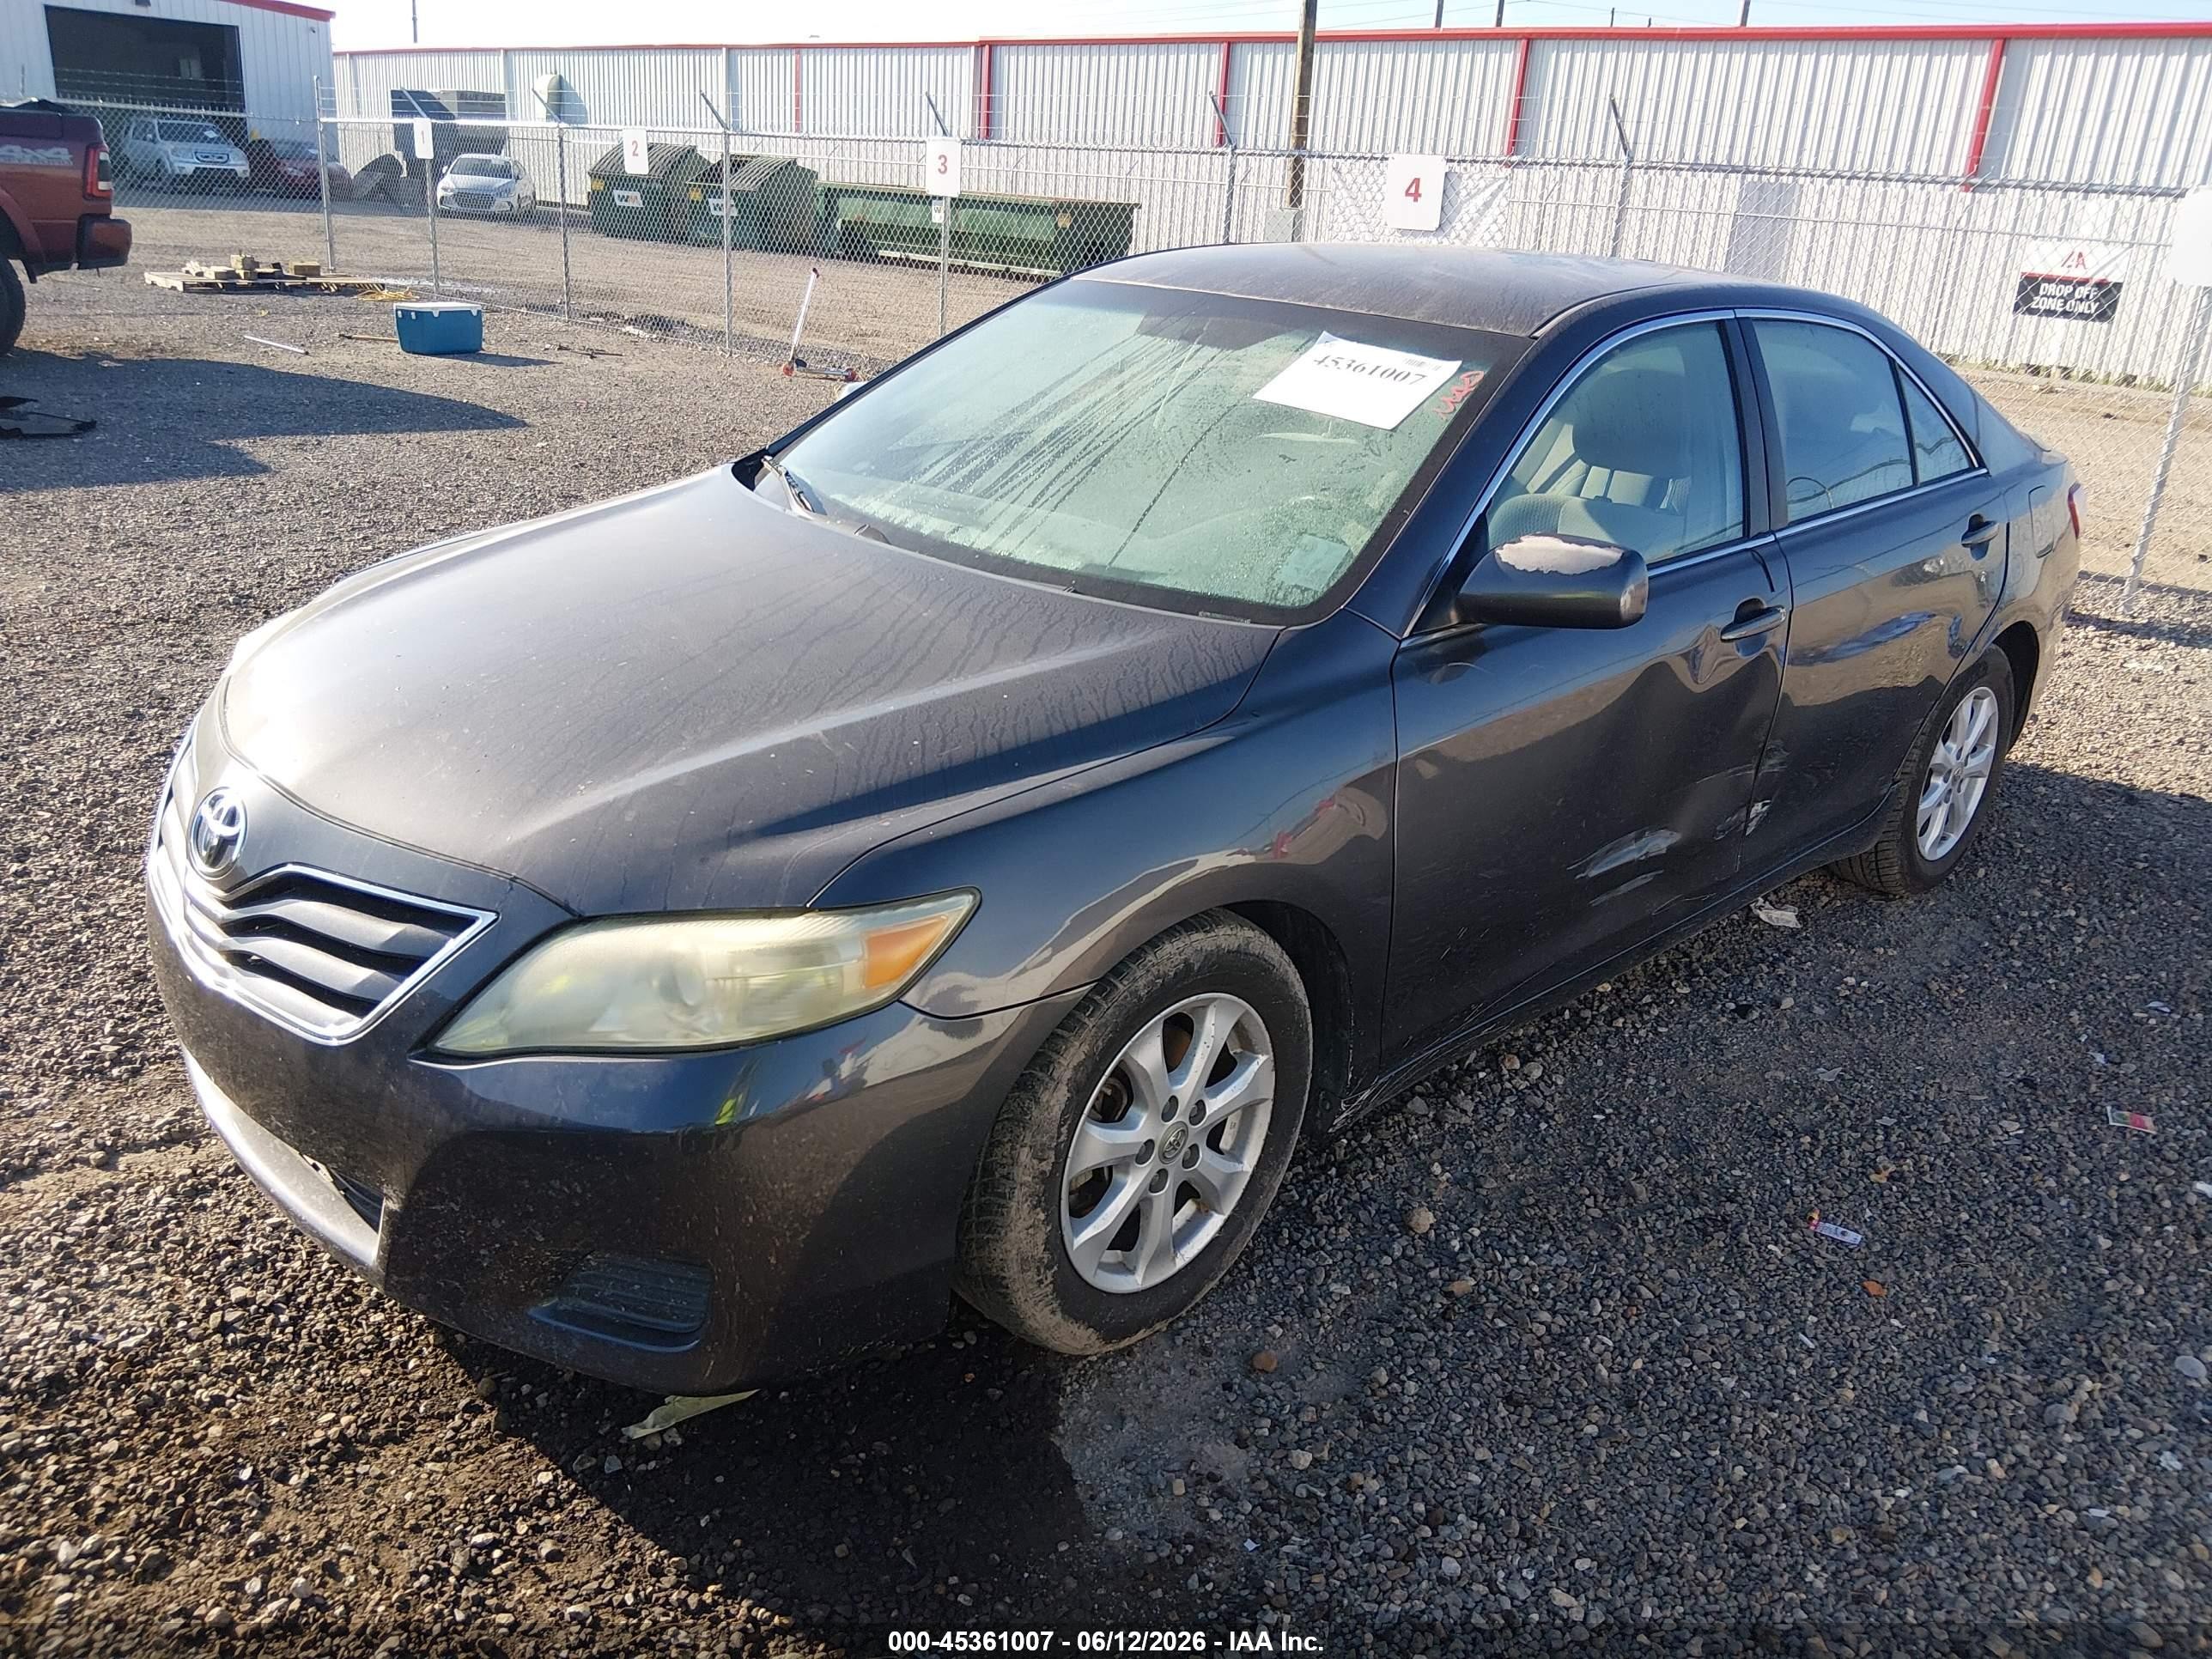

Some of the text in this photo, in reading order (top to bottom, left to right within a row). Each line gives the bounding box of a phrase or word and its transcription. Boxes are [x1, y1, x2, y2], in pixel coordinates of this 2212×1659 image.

[631, 140, 640, 157] 2
[937, 155, 948, 175] 3
[1405, 177, 1422, 203] 4
[2039, 283, 2100, 300] DROP OFF
[2031, 296, 2100, 314] ZONE ONLY
[1313, 355, 1428, 386] 45361007
